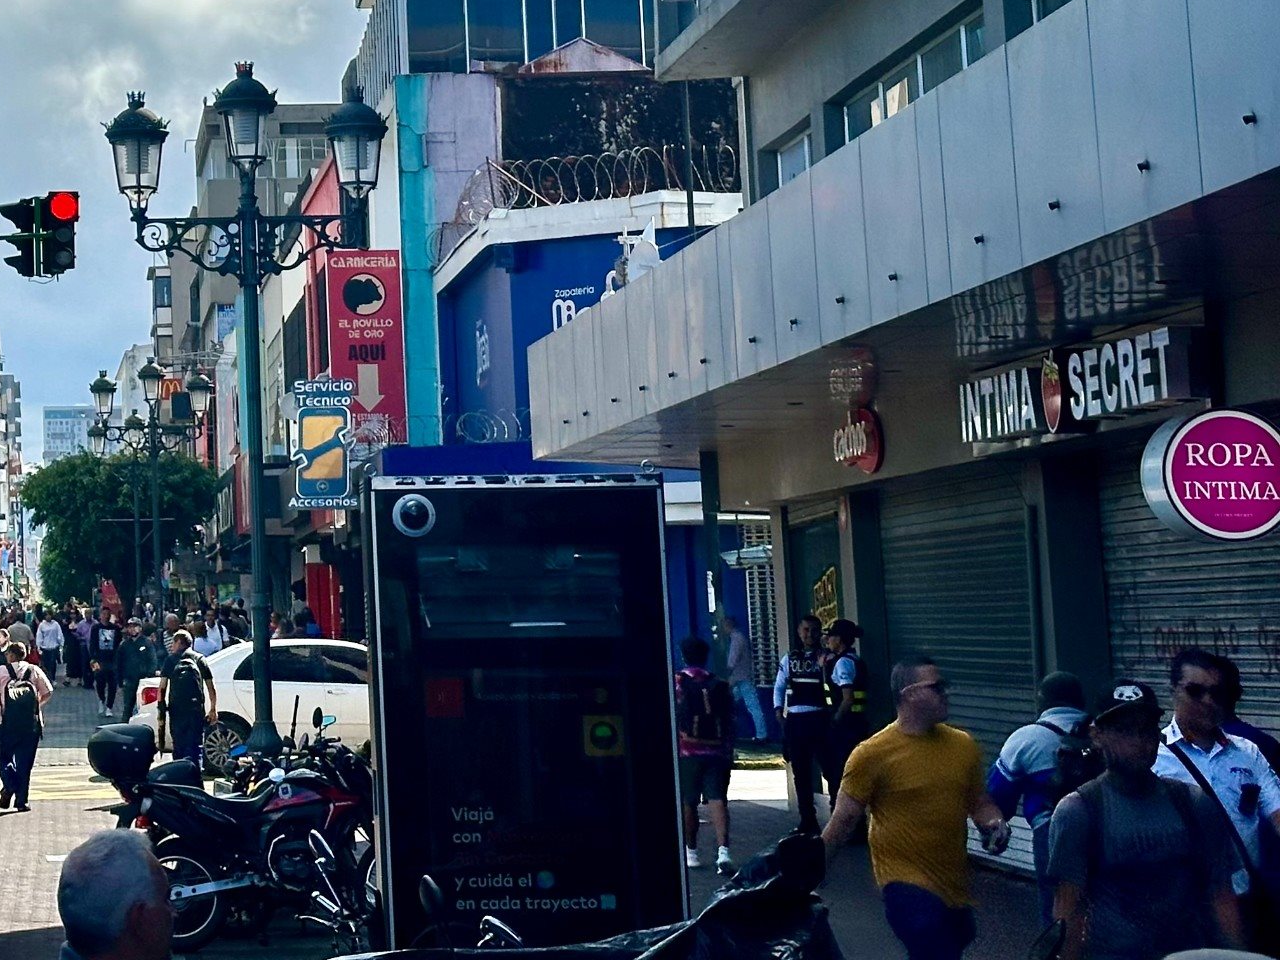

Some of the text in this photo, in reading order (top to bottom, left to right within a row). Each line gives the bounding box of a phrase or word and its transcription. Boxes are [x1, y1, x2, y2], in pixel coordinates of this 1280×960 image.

[330, 253, 397, 268] CARNICERÍA
[338, 319, 351, 328] EL
[348, 330, 384, 338] DE ORO
[348, 341, 386, 362] AQUÍ
[294, 380, 353, 392] Servicio
[959, 367, 1037, 443] INTIMA
[1068, 326, 1170, 421] SECRET
[1184, 442, 1274, 467] ROPA
[1183, 481, 1280, 500] INTIMA
[288, 497, 358, 507] Accesorios
[451, 806, 494, 824] Viajá
[453, 832, 482, 843] con
[455, 873, 532, 891] y cuidá el
[456, 896, 598, 912] en cada trayecto
